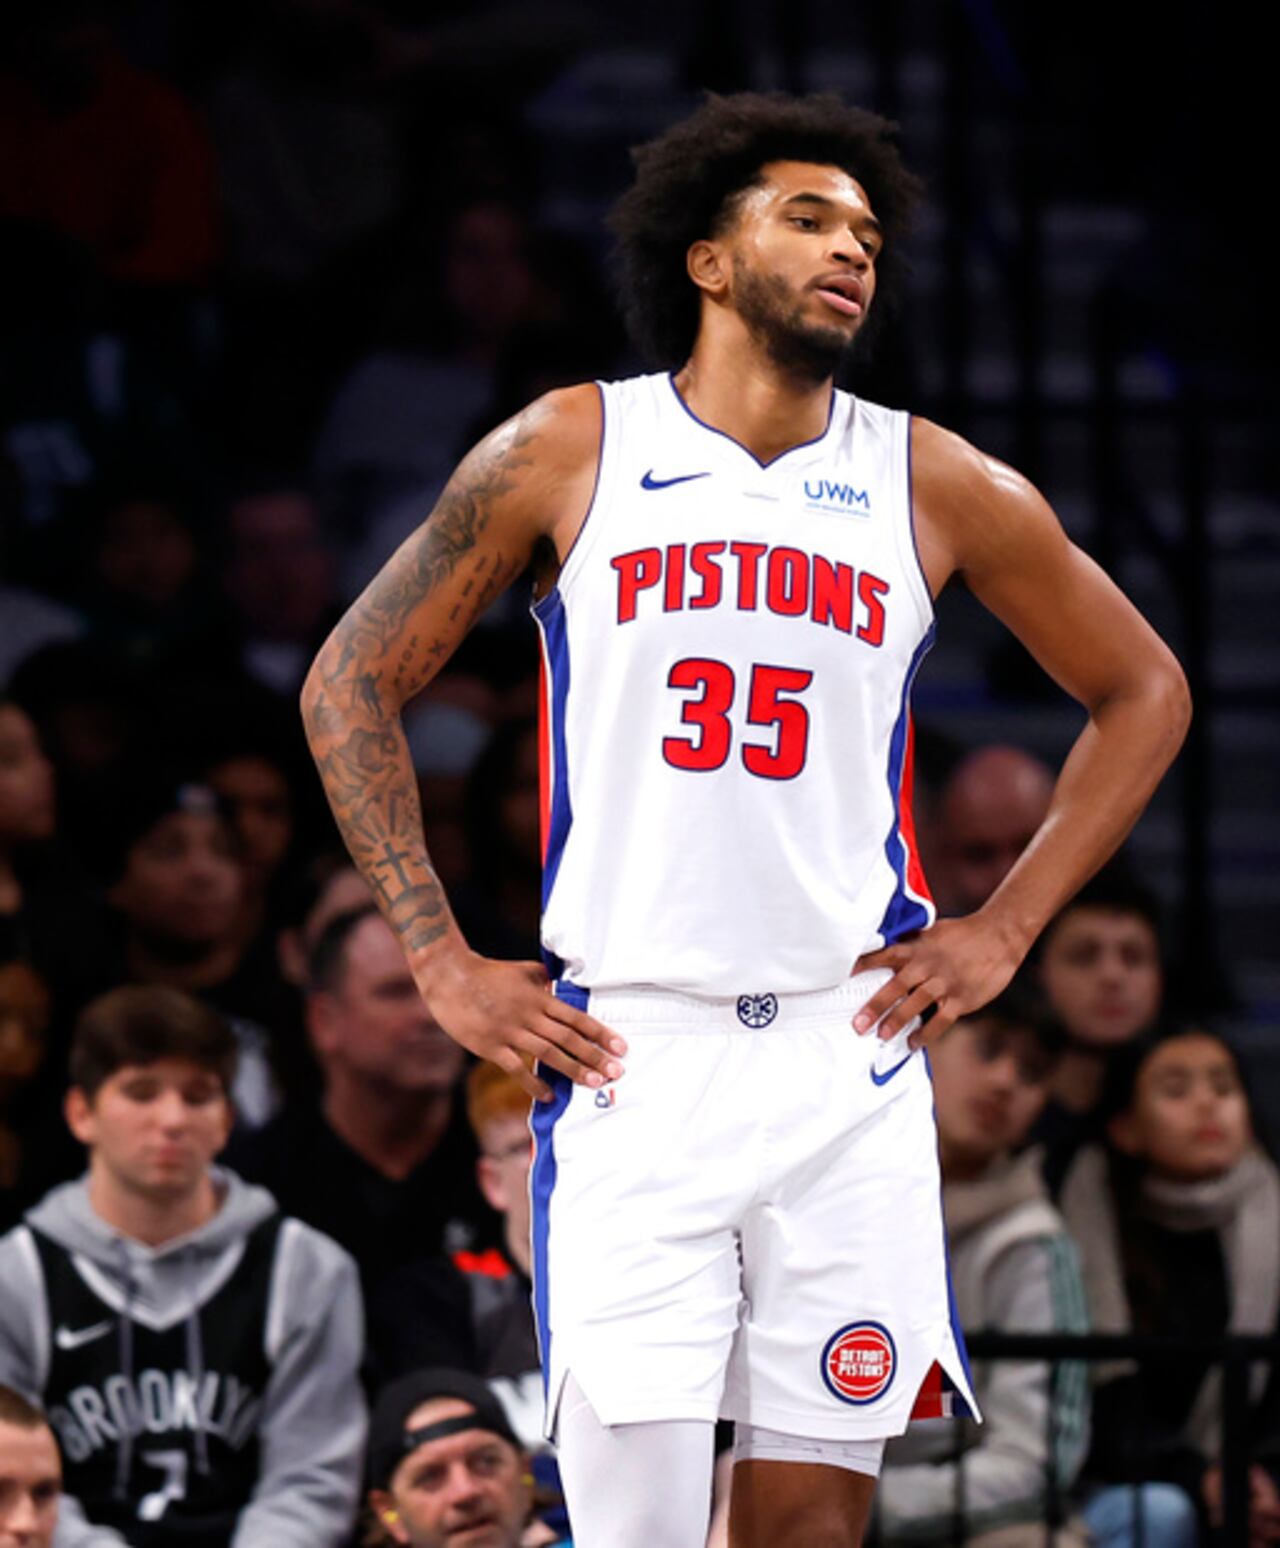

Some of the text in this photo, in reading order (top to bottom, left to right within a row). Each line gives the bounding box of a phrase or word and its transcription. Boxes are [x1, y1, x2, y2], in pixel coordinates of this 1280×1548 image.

[803, 479, 871, 509] UWM
[609, 540, 890, 648] PISTONS
[661, 656, 814, 781] 35
[136, 1448, 190, 1521] 7
